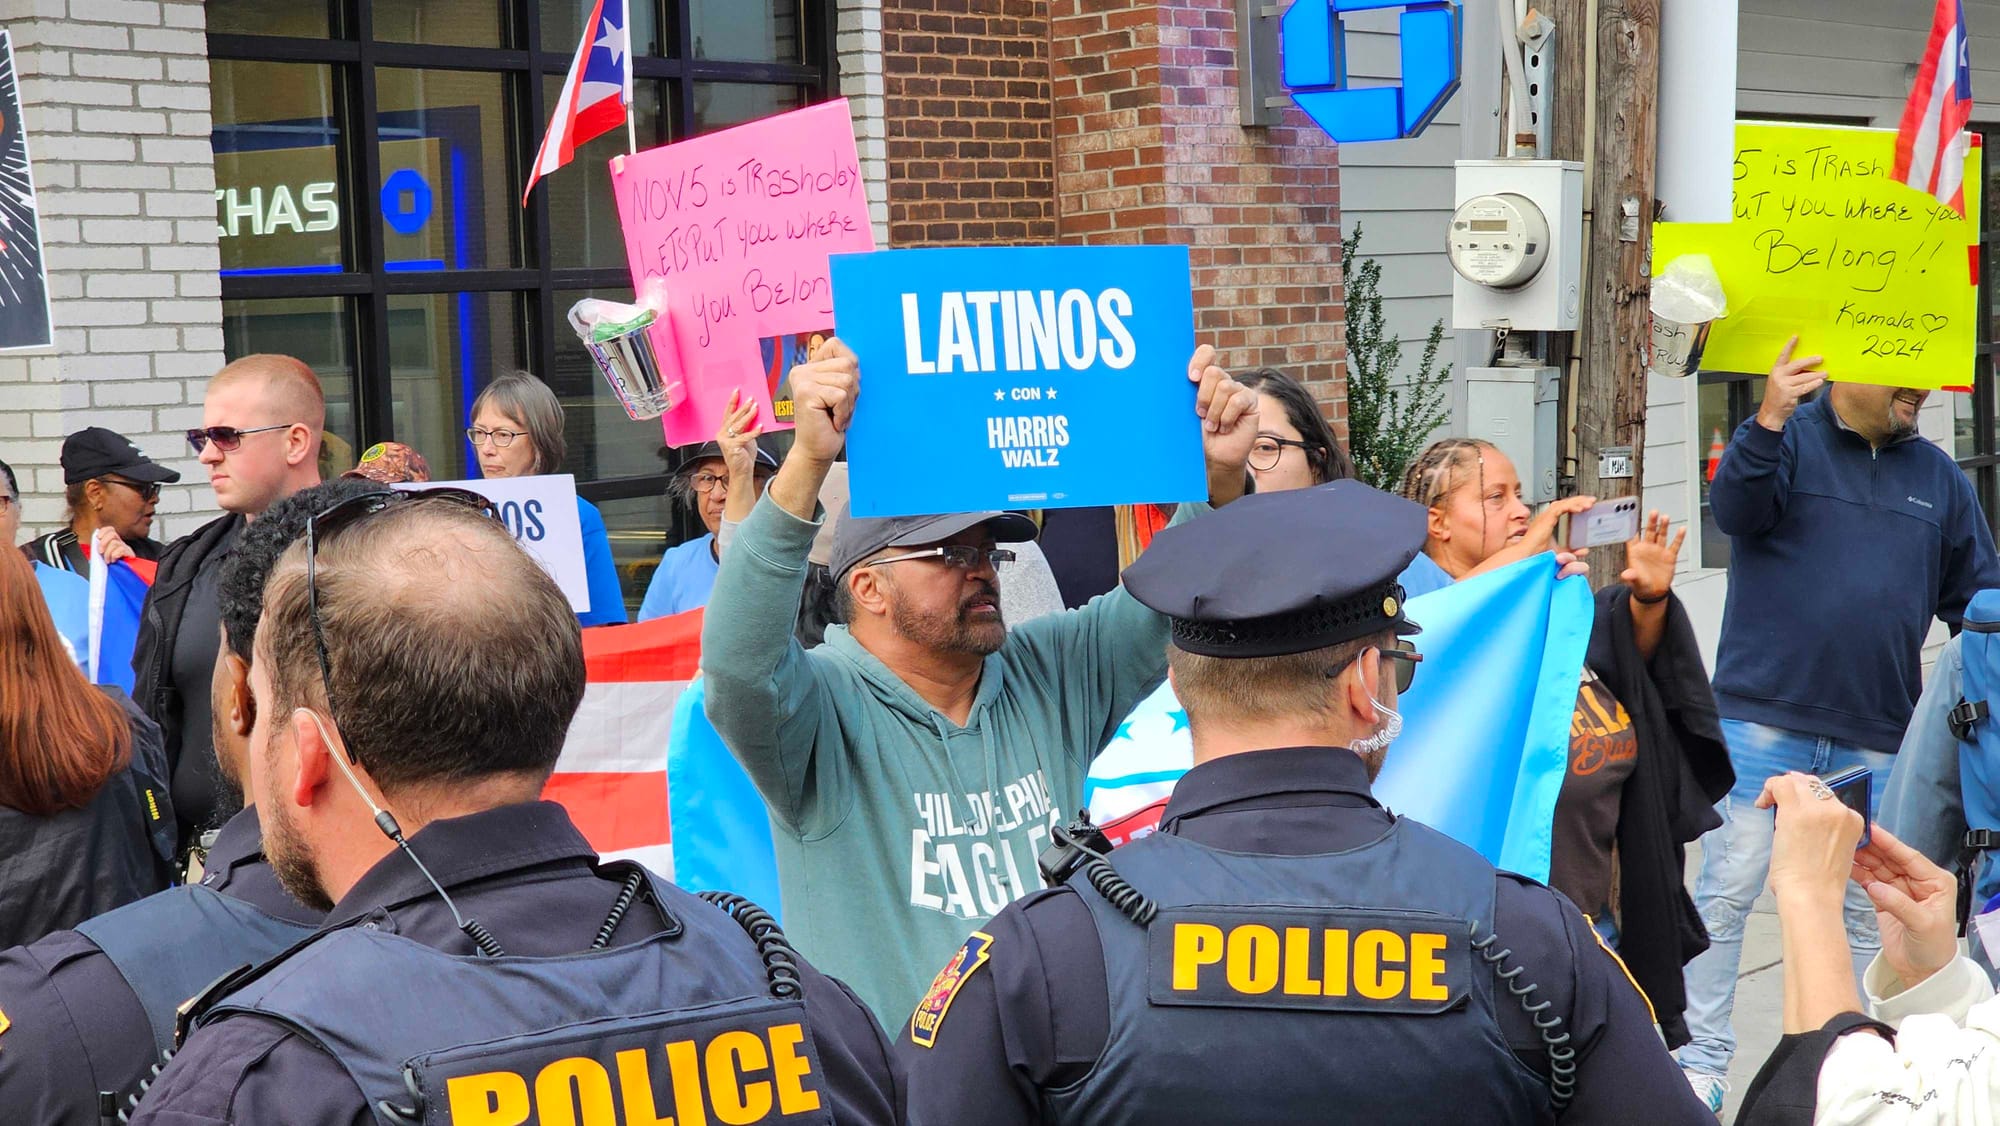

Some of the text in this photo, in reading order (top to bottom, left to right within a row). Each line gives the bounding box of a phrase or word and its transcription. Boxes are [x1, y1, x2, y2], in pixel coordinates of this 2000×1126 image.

[1773, 153, 1797, 176] is
[721, 172, 737, 197] is
[215, 181, 339, 237] HAS
[1835, 300, 1915, 329] Kamala
[901, 287, 1137, 375] LATINOS
[1652, 321, 1686, 339] ash
[1862, 334, 1929, 361] 2024
[1011, 387, 1041, 401] CON
[987, 415, 1070, 449] HARRIS
[1001, 448, 1060, 468] WALZ
[497, 499, 546, 541] OS
[1172, 922, 1449, 1000] POLICE
[446, 1023, 820, 1126] POLICE
